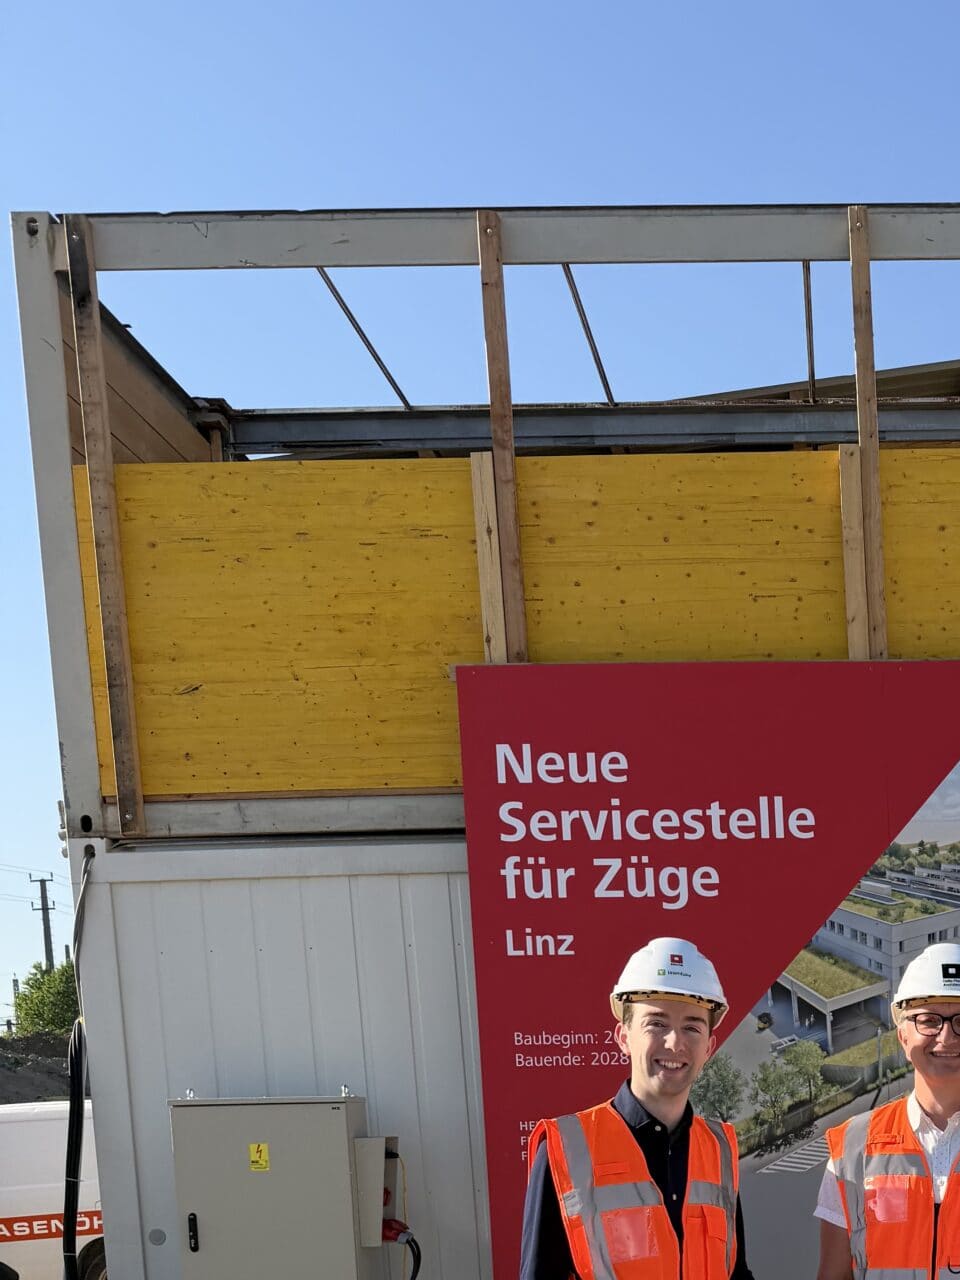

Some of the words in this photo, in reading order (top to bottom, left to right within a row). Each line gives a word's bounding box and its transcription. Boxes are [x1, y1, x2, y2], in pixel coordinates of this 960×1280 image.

[495, 743, 628, 784] Neue
[498, 795, 816, 843] Servicestelle
[500, 855, 576, 899] für
[593, 855, 720, 910] Züge
[505, 927, 576, 957] Linz
[514, 1030, 599, 1049] Baubeginn:
[515, 1052, 586, 1067] Bauende:
[591, 1052, 630, 1066] 2028
